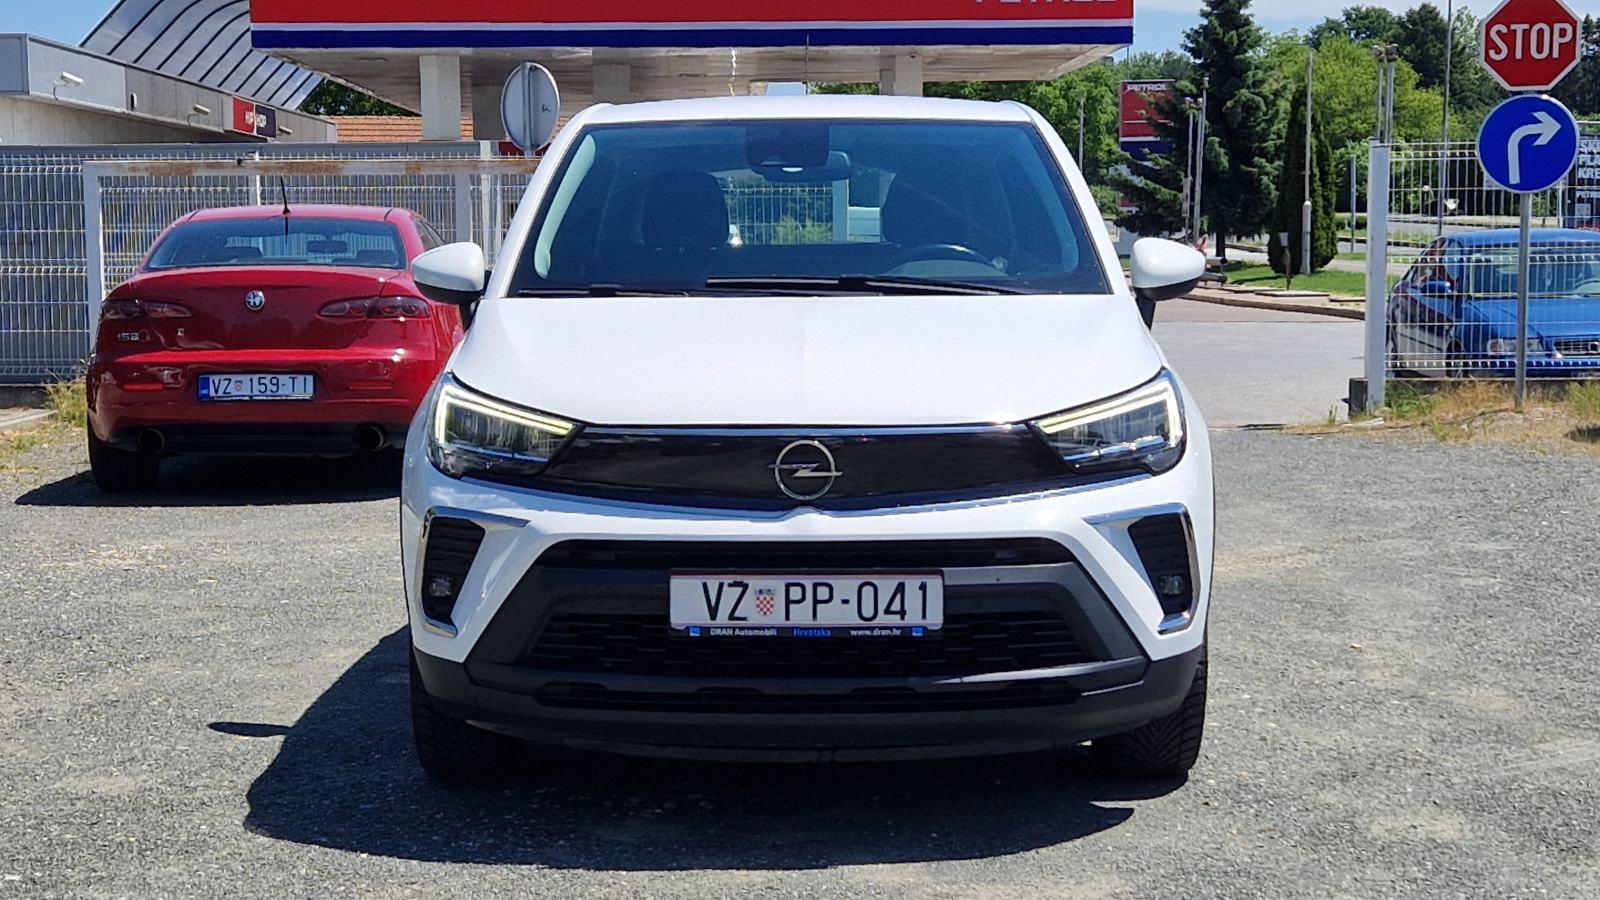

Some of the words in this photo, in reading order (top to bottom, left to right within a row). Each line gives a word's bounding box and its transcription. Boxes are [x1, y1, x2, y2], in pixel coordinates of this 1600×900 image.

[1488, 22, 1573, 60] STOP
[248, 376, 308, 394] 159-TI
[783, 580, 928, 622] PP-041
[710, 627, 733, 636] DRAN
[734, 627, 778, 636] Automobili
[793, 627, 832, 637] Hrvatska
[850, 627, 902, 636] www.dran.hr
